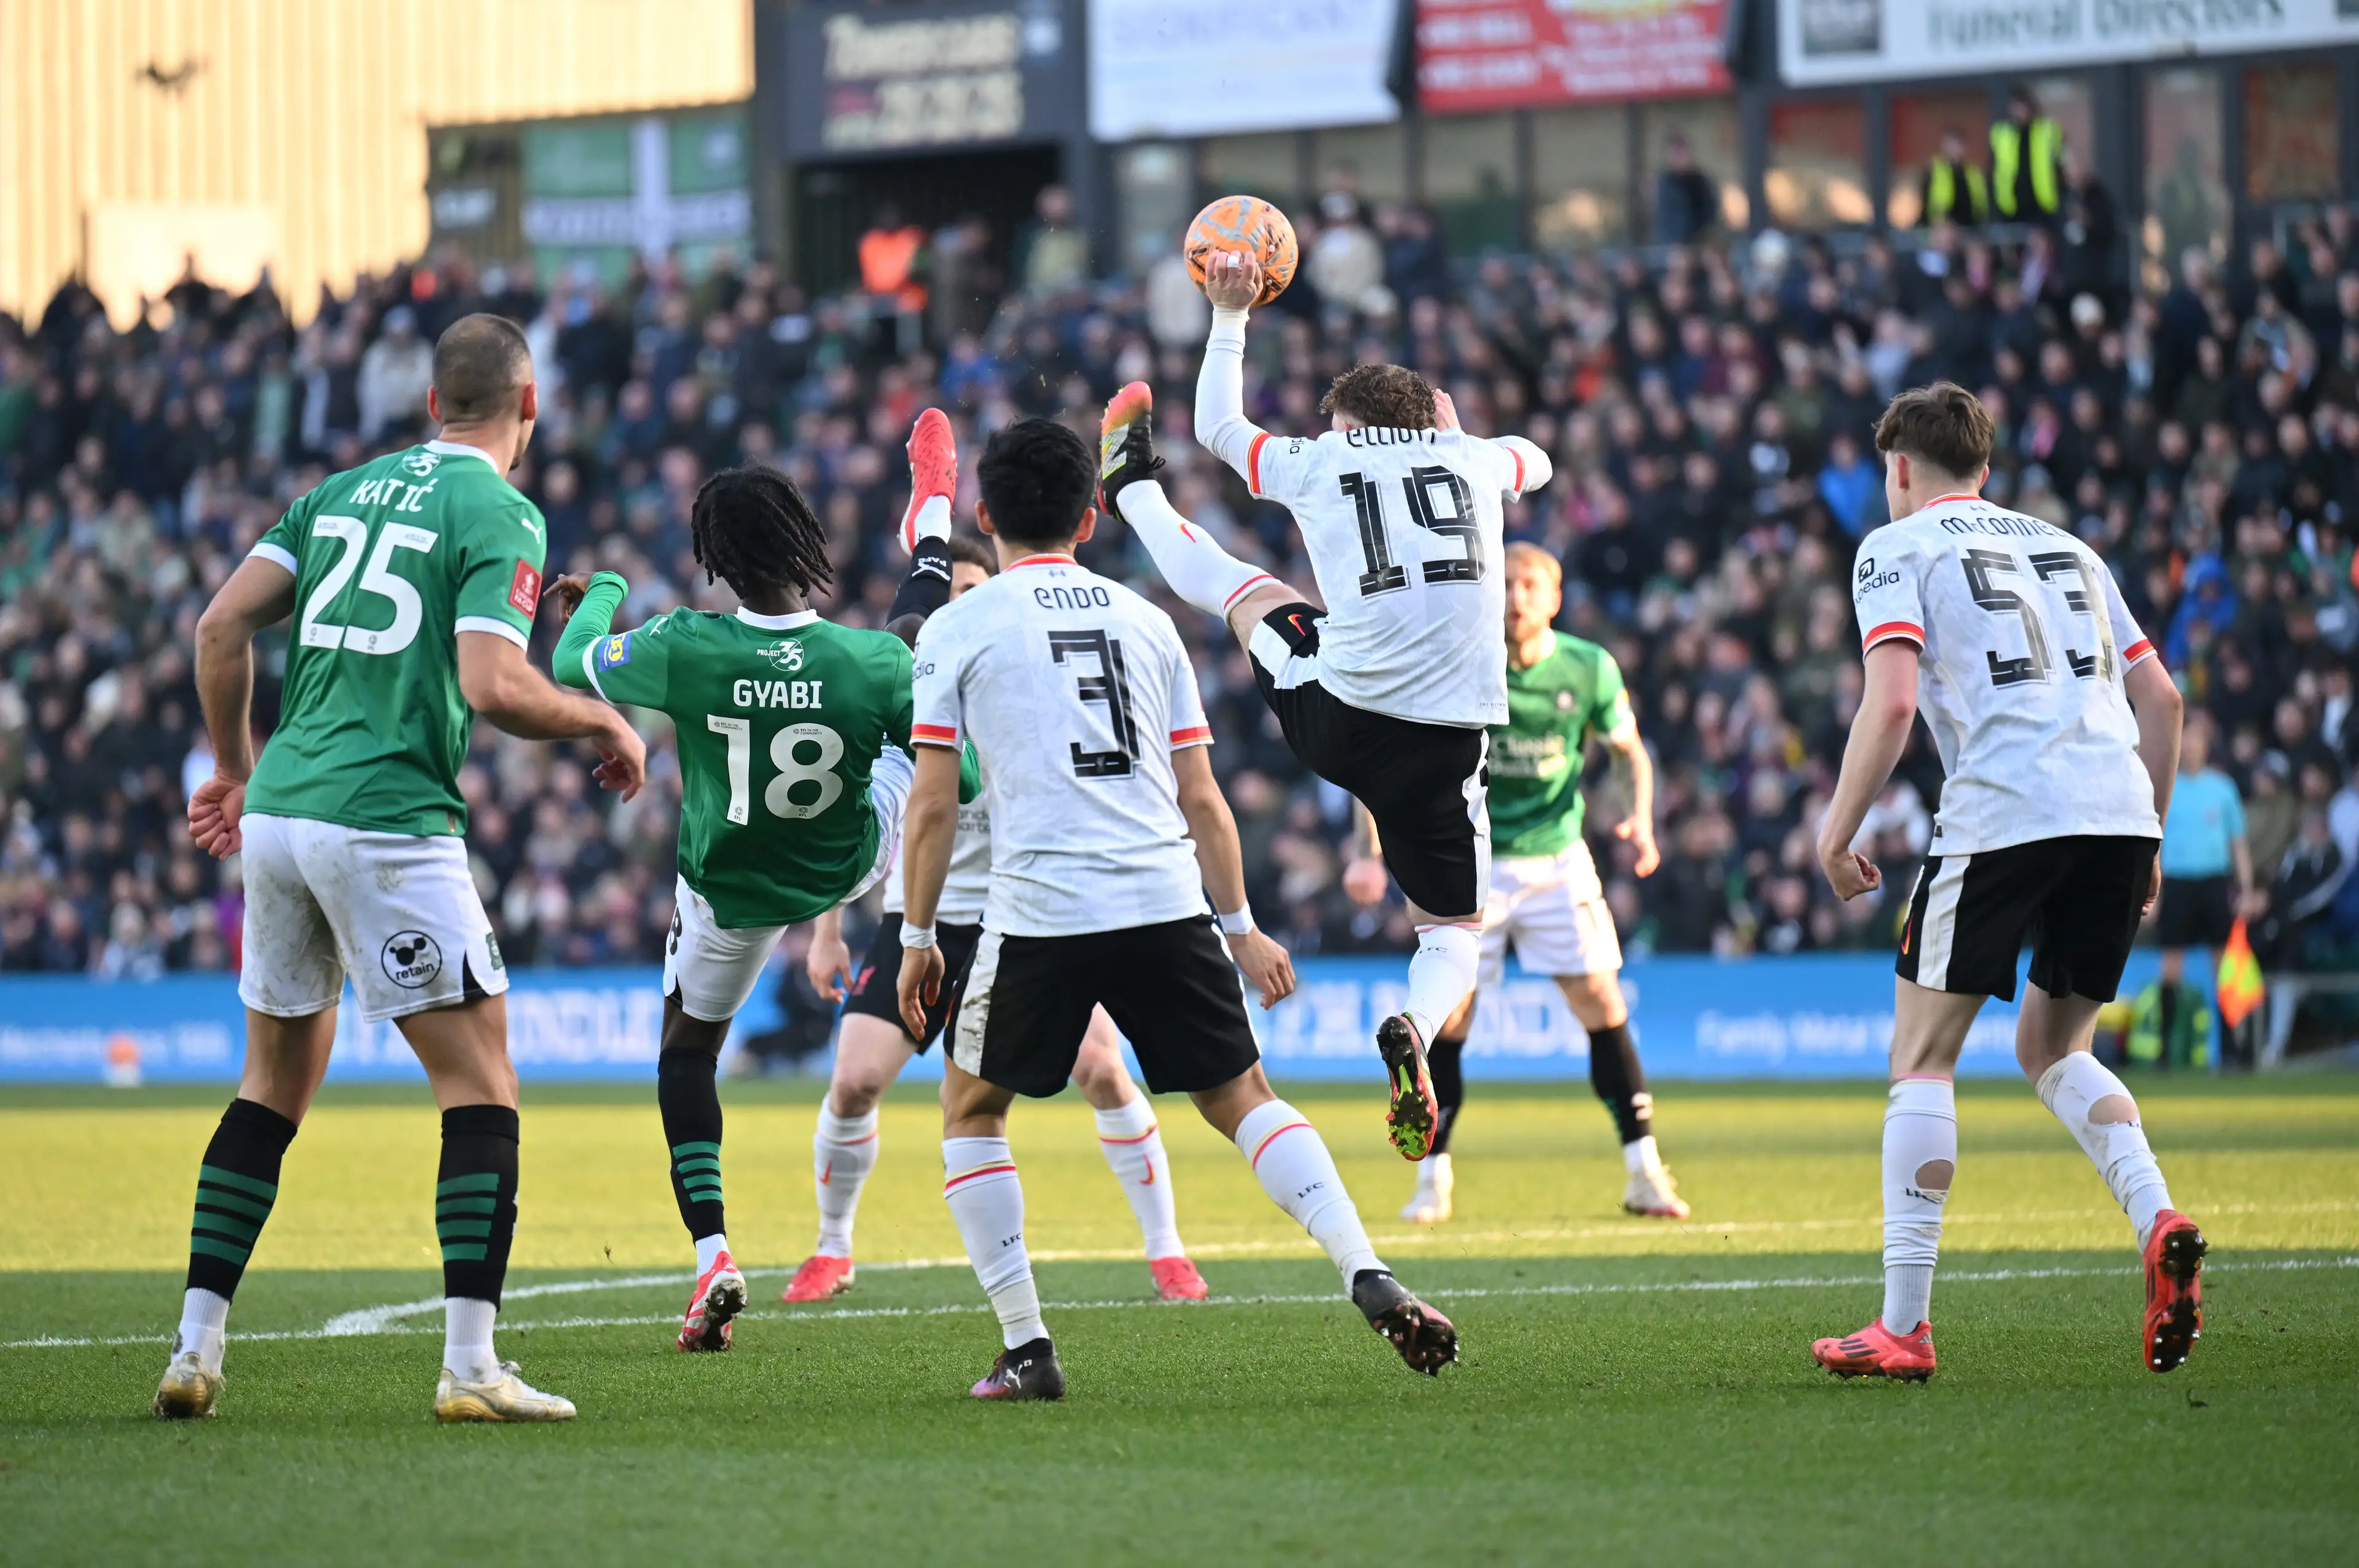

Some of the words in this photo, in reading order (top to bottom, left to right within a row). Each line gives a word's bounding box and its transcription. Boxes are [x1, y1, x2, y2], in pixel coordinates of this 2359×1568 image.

[350, 478, 439, 512] KATIĆ
[1339, 464, 1488, 598] 19
[300, 515, 439, 655] 25
[1960, 548, 2114, 688] 53
[757, 649, 781, 657] PROJECT
[778, 641, 804, 671] 35
[733, 679, 823, 709] GYABI
[1047, 629, 1143, 781] 3
[707, 713, 844, 825] 18
[396, 962, 435, 981] retain
[1297, 1181, 1324, 1199] LFC
[1001, 1232, 1022, 1247] LFC
